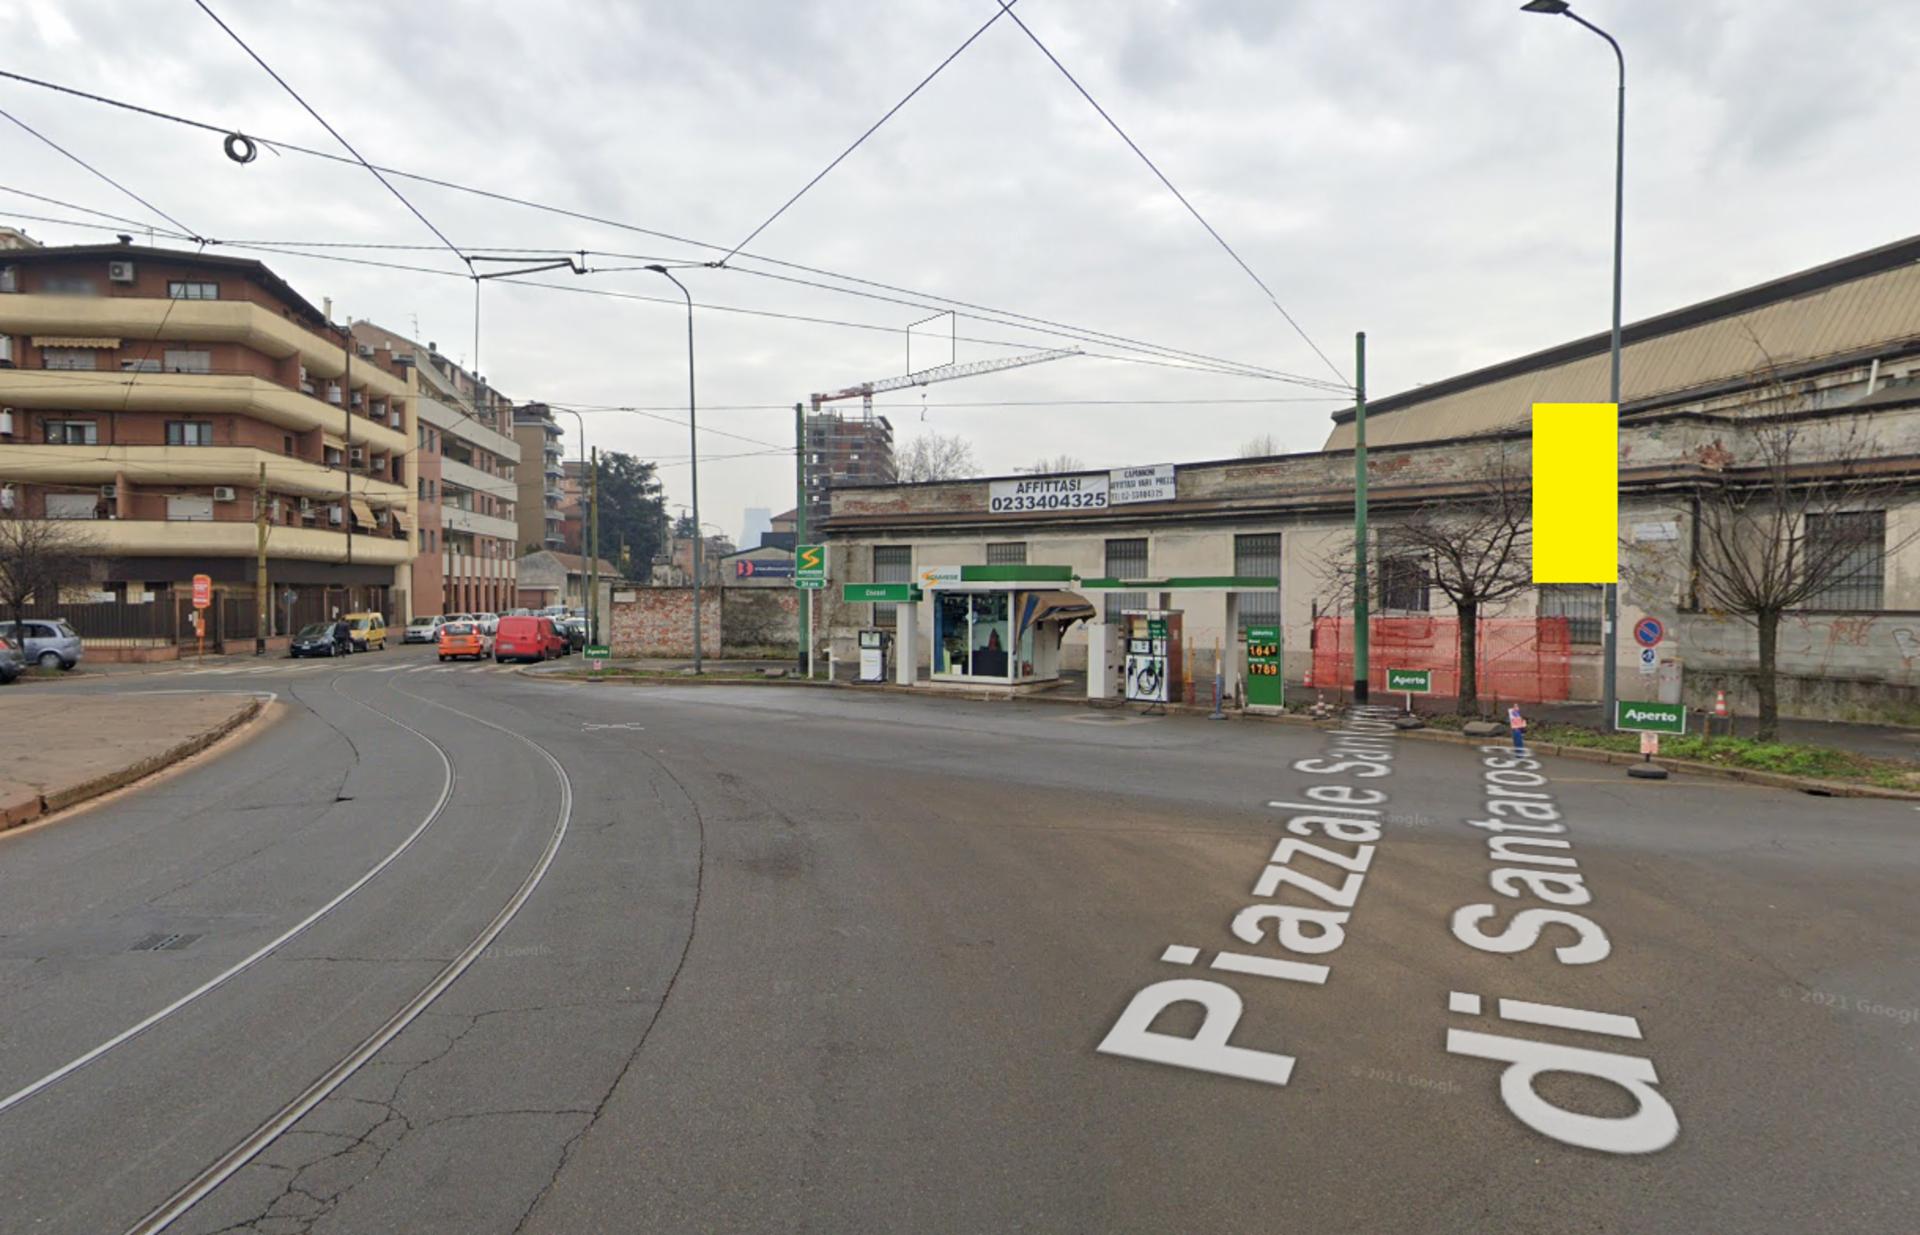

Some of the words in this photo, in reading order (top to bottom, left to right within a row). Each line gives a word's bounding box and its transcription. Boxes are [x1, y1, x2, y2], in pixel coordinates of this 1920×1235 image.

[1016, 479, 1081, 494] AFFITTASI
[992, 492, 1106, 511] 0233404325
[1392, 675, 1426, 686] Aperto
[1624, 708, 1678, 722] Aperto
